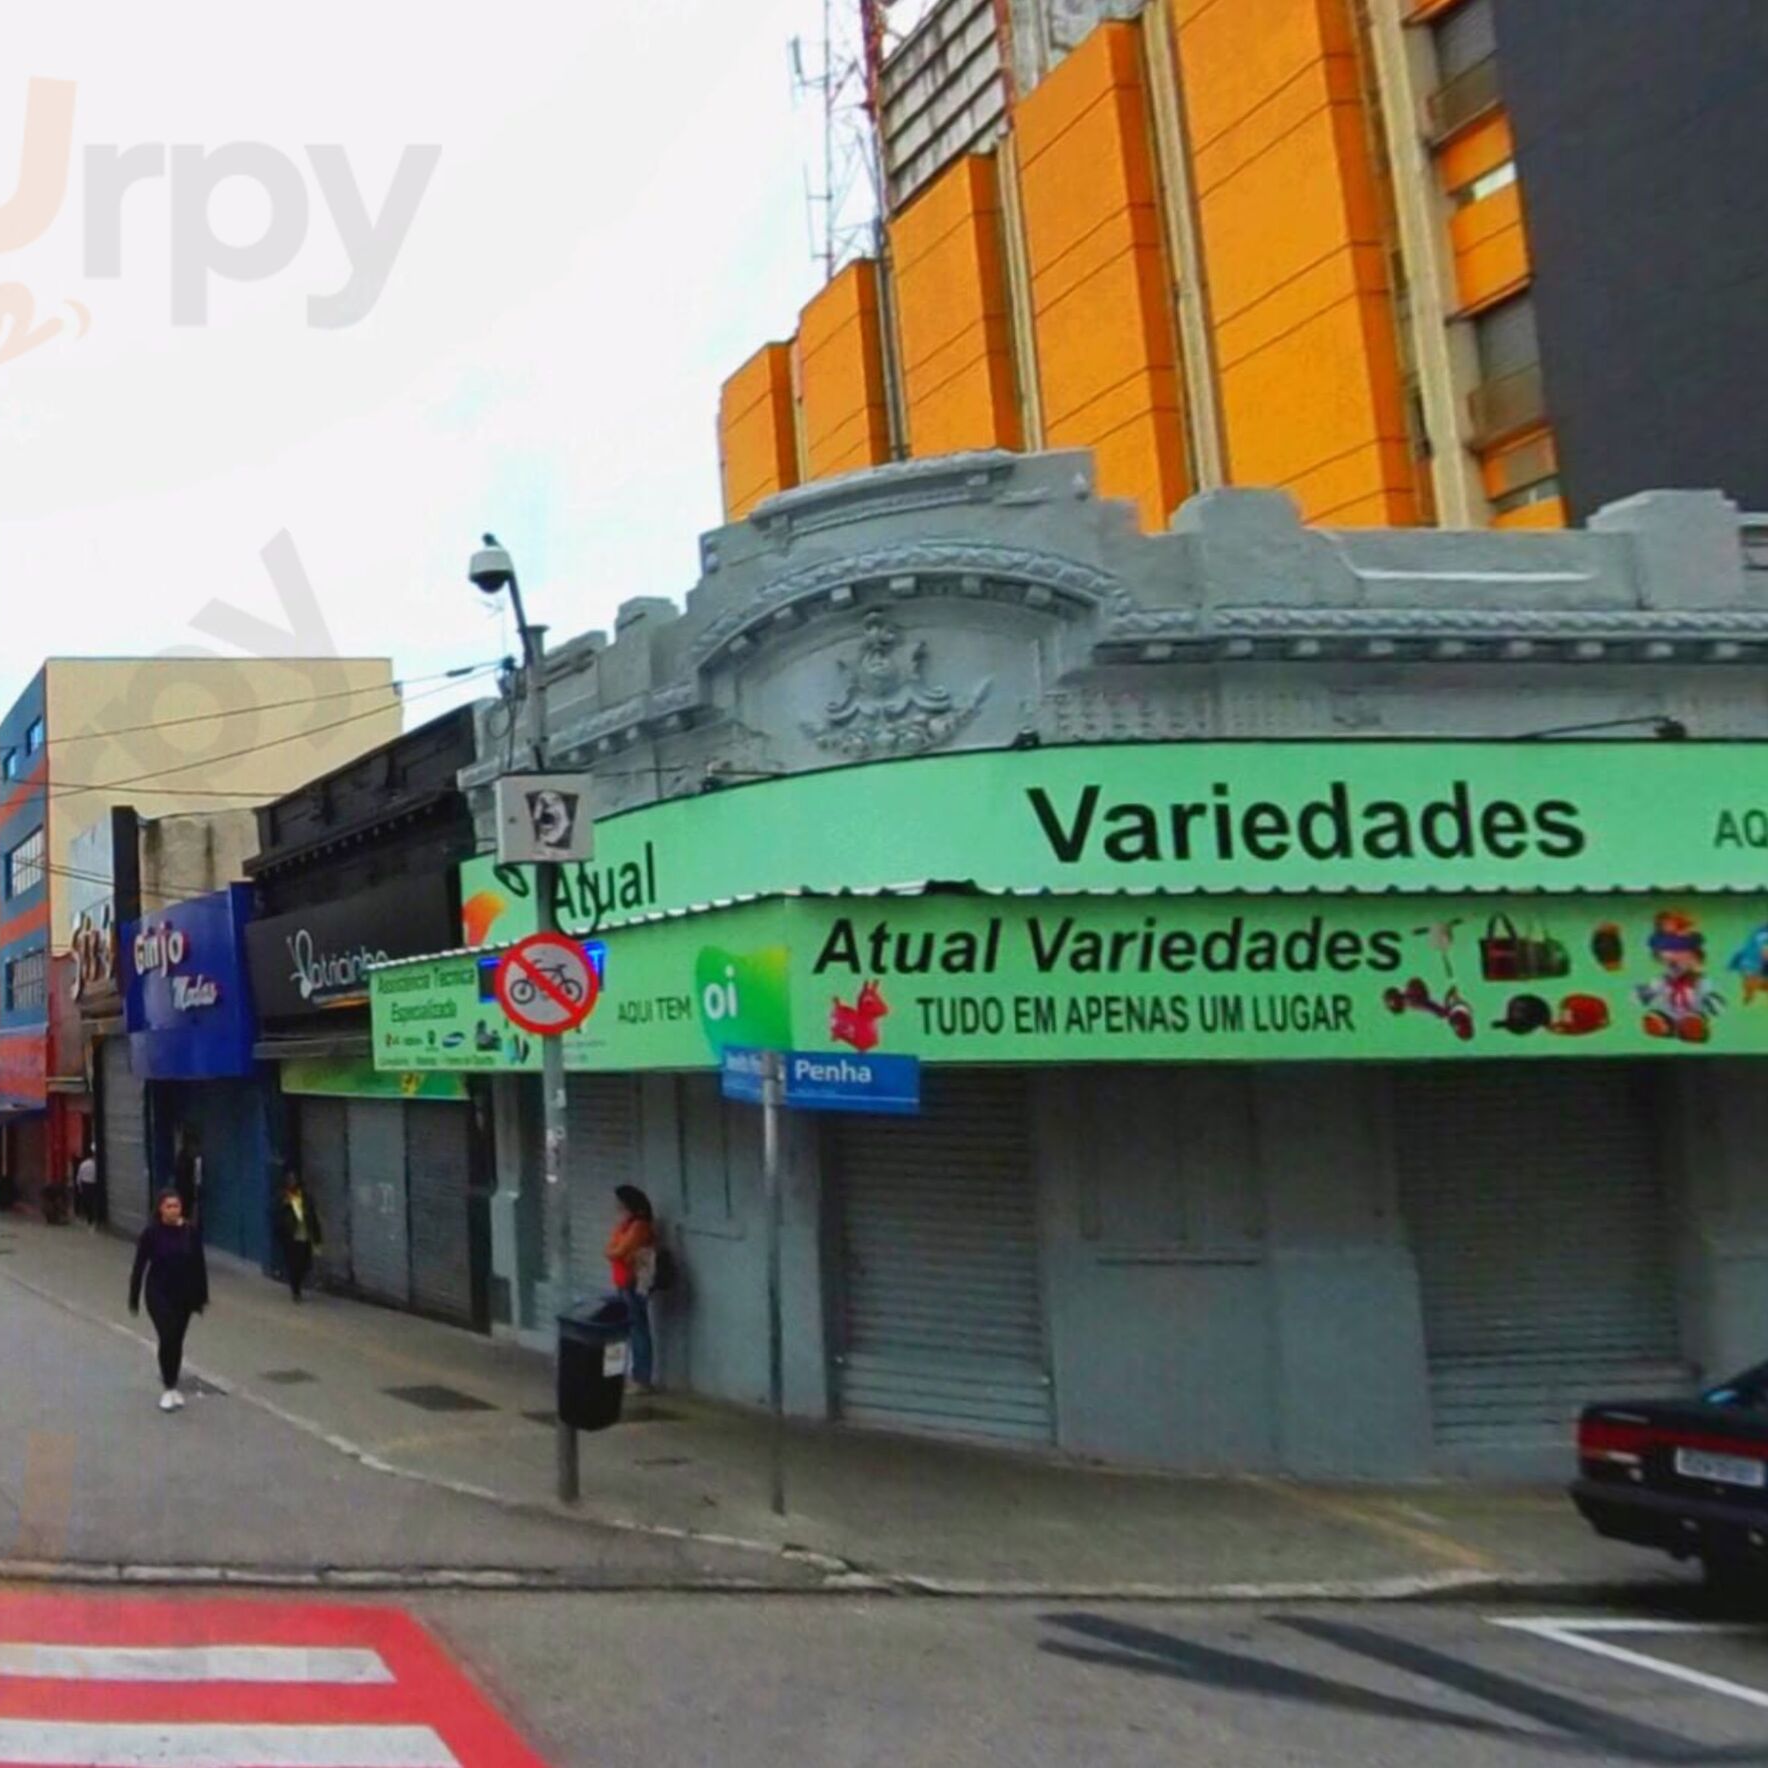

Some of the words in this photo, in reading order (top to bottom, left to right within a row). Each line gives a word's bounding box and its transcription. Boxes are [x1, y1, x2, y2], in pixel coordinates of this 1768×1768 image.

[553, 840, 657, 921] Atual
[1027, 782, 1585, 863] Variedades
[134, 920, 188, 978] Ginjo
[813, 917, 1002, 974] Atual
[1028, 916, 1402, 973] Variedades
[618, 999, 653, 1024] AQUI
[656, 996, 692, 1022] TEM
[703, 964, 738, 1020] oi
[916, 996, 1004, 1035] TUDO
[1014, 995, 1057, 1034] EM
[1064, 995, 1190, 1034] APENAS
[1199, 995, 1245, 1033] UM
[1252, 994, 1356, 1032] LUGAR
[794, 1058, 873, 1084] Penha
